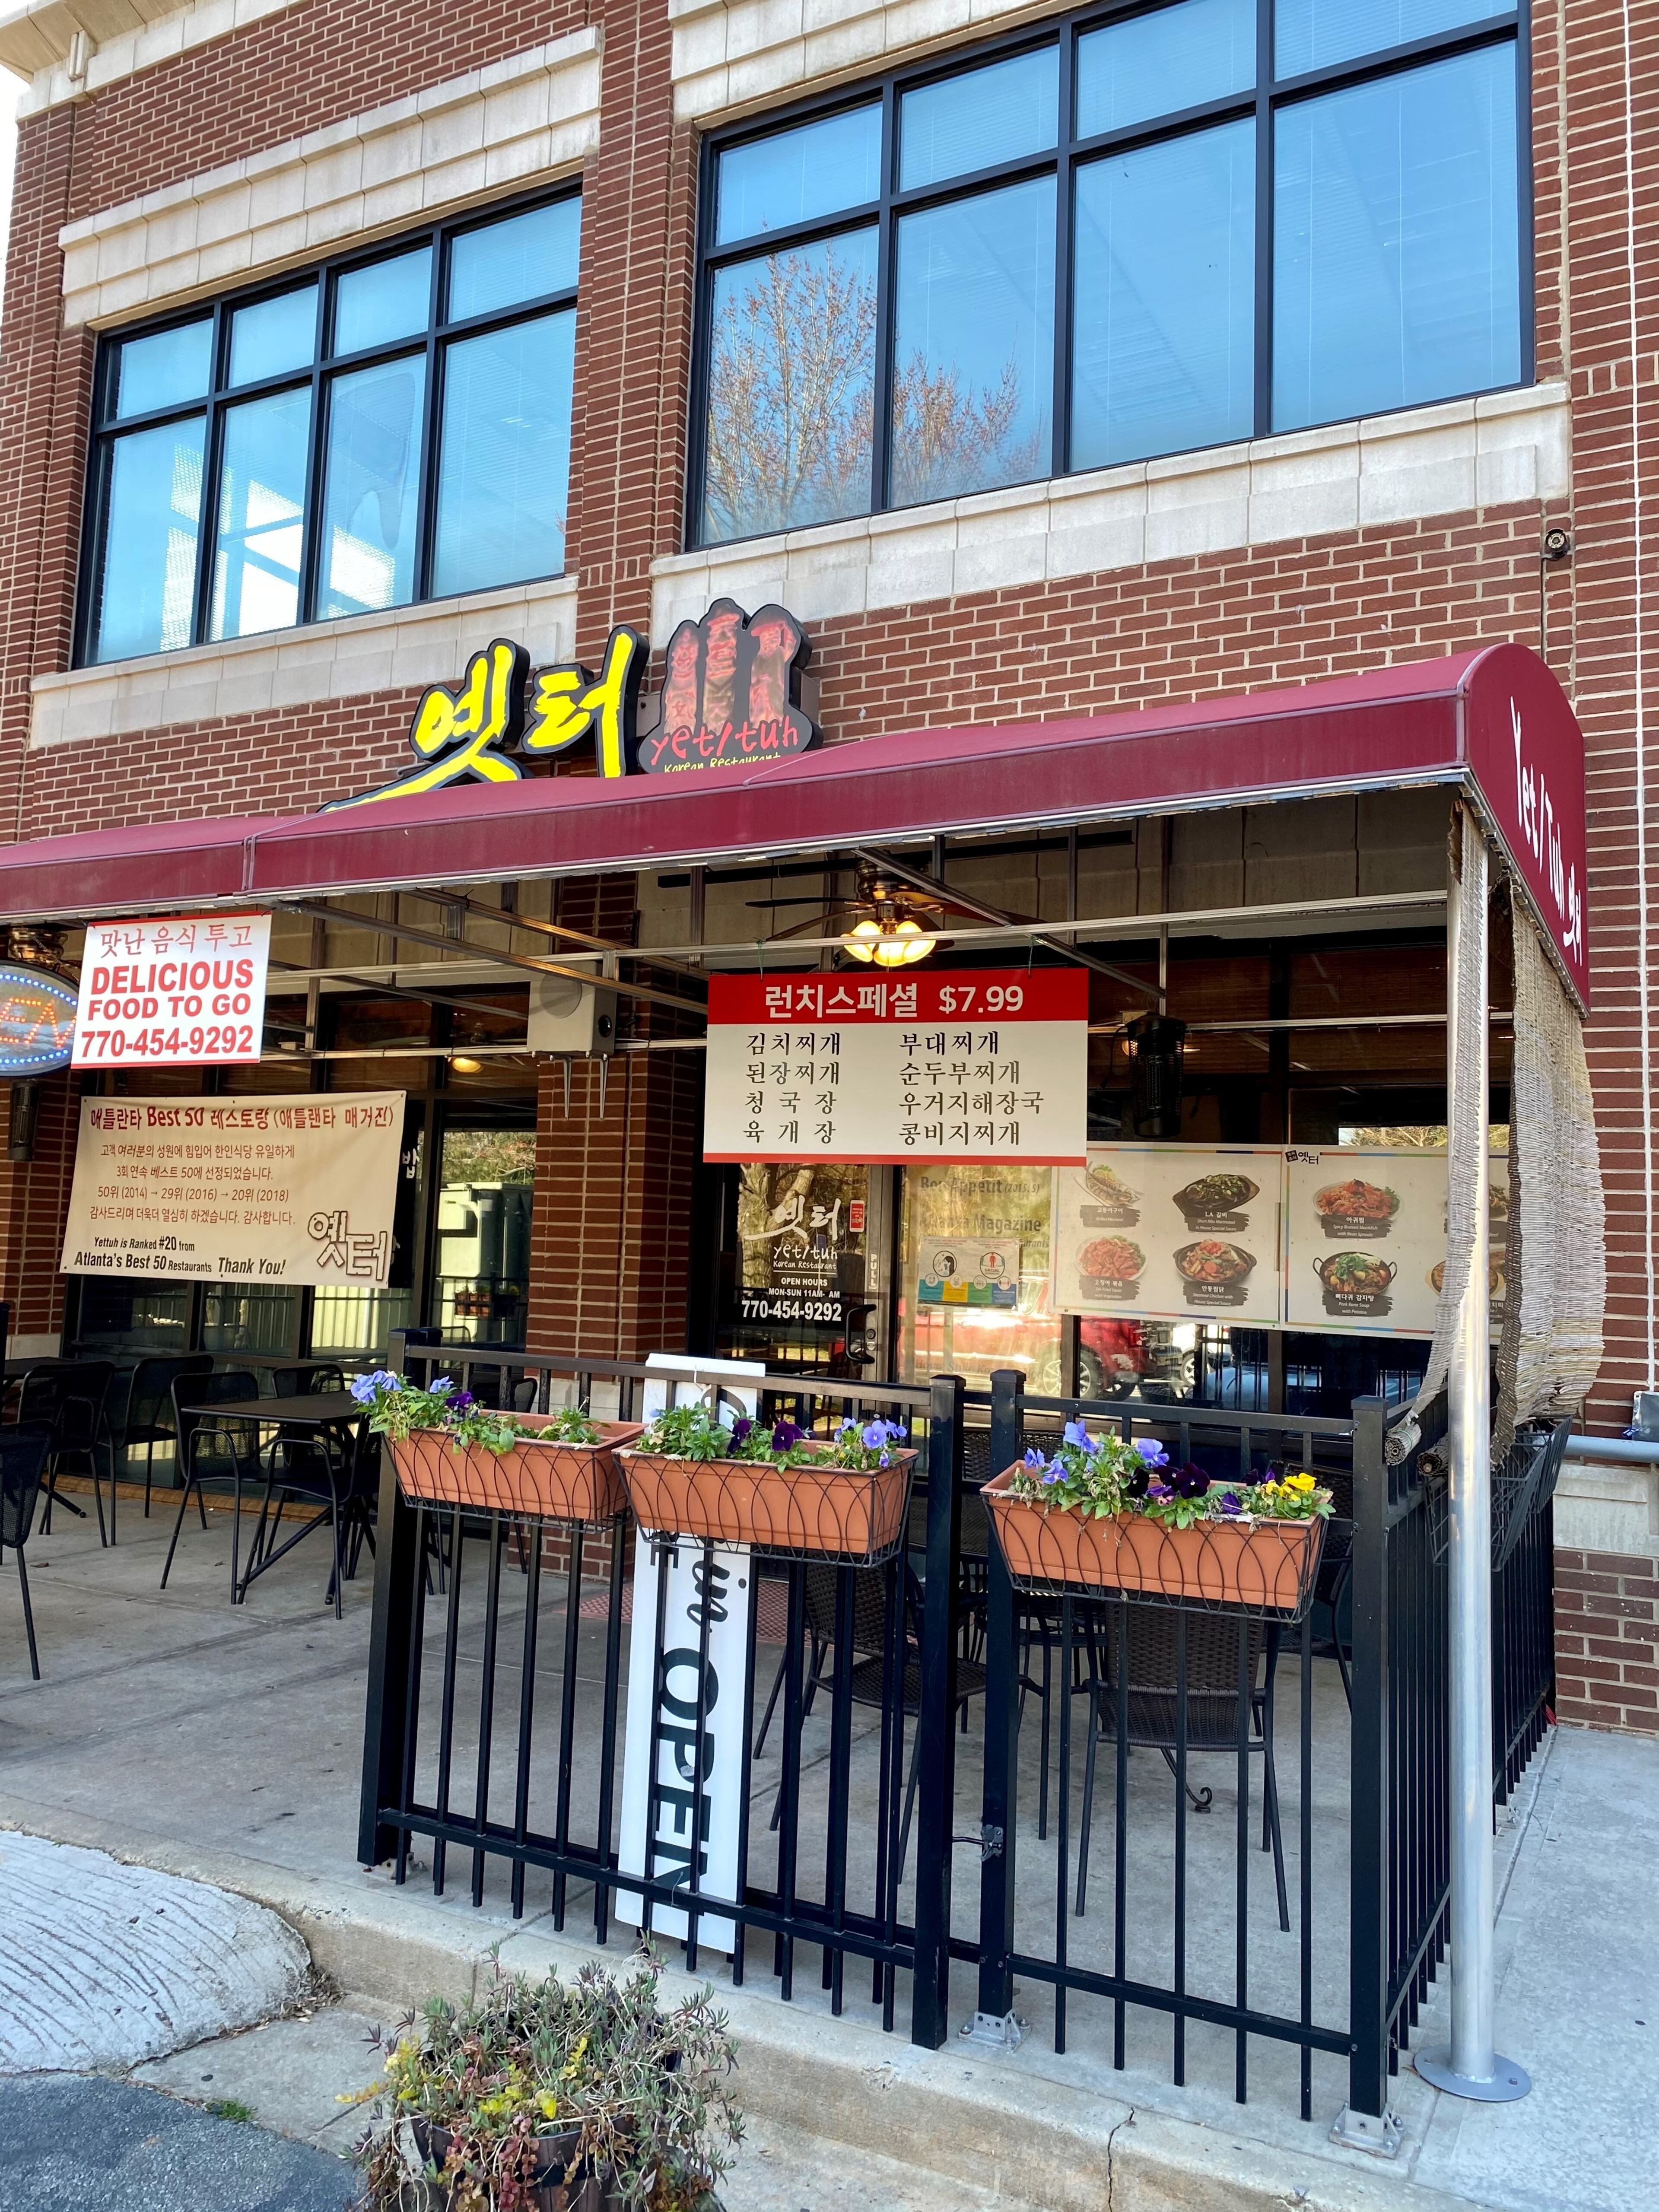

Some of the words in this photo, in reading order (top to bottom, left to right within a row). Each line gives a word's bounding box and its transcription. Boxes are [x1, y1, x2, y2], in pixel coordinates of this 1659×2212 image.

[324, 632, 633, 812] 옛터
[651, 715, 798, 765] yet/tuh
[664, 760, 704, 773] Korean
[101, 928, 145, 958] 맛난
[151, 925, 196, 954] 음식
[204, 924, 252, 952] 투고
[91, 959, 253, 995] DELICIOUS
[88, 997, 158, 1020] FOOD
[168, 995, 202, 1017] TO
[212, 993, 251, 1015] GO
[765, 983, 918, 1018] 런치스페셜
[938, 985, 1024, 1014] $7.99
[82, 1025, 253, 1057] 770-454-9292
[746, 1032, 842, 1057] 김치찌개
[899, 1031, 999, 1057] 부대찌개
[745, 1061, 840, 1086] 된장찌개
[899, 1060, 1020, 1087] 순두부찌개
[899, 1090, 1045, 1116] 우거지해장국
[91, 1107, 142, 1130] 애틀란타
[147, 1106, 181, 1127] Best
[184, 1107, 205, 1127] 50
[210, 1107, 270, 1130] 레스토랑
[273, 1108, 336, 1129] (애틀랜타
[345, 1106, 393, 1128] 매거진)
[898, 1121, 1020, 1146] 콩비지찌개
[100, 1144, 116, 1158] 고객
[118, 1144, 154, 1158] 여러분의
[156, 1144, 183, 1159] 성원에
[185, 1144, 212, 1159] 힘입어
[215, 1144, 252, 1159] 한인식당
[255, 1144, 295, 1159] 유일하게
[1298, 1151, 1319, 1165] 옛터
[116, 1165, 128, 1179] 3회
[130, 1165, 148, 1179] 연속
[150, 1166, 178, 1179] 베스트
[181, 1166, 202, 1180] 50에
[205, 1166, 273, 1181] 선정되었습니다.
[98, 1185, 119, 1199] 50위
[121, 1186, 147, 1200] (2014)
[161, 1187, 183, 1201] 29위
[185, 1188, 217, 1202] (2016)
[232, 1188, 254, 1202] 20위
[256, 1189, 289, 1203] (2018)
[90, 1206, 133, 1220] 감사드리며
[136, 1208, 159, 1221] 더욱더
[162, 1208, 188, 1223] 열심히
[191, 1209, 240, 1224] 하겠습니다.
[243, 1211, 296, 1225] 감사합니다.
[744, 1195, 841, 1241] 옛터
[974, 1214, 1042, 1234] Magazine
[94, 1237, 118, 1248] Yettuh
[120, 1238, 127, 1248] is
[129, 1238, 157, 1250] Ranked
[159, 1236, 177, 1251] #20
[179, 1240, 195, 1252] from
[307, 1210, 387, 1281] 옛터
[773, 1244, 838, 1260] yet/tuh
[74, 1251, 122, 1268] Atlanta's
[125, 1254, 151, 1269] Best
[153, 1255, 167, 1270] 50
[168, 1259, 212, 1273] Restaurants
[219, 1257, 254, 1274] Thank
[259, 1258, 286, 1275] You!
[773, 1260, 796, 1269] Korean
[798, 1261, 836, 1270] Restaurant
[870, 1254, 878, 1287] PULL
[768, 1288, 801, 1297] MON-SUN
[781, 1277, 800, 1285] OPEN
[802, 1278, 828, 1287] HOURS
[741, 1300, 842, 1322] 770-454-9292
[650, 1647, 719, 1916] OPEN
